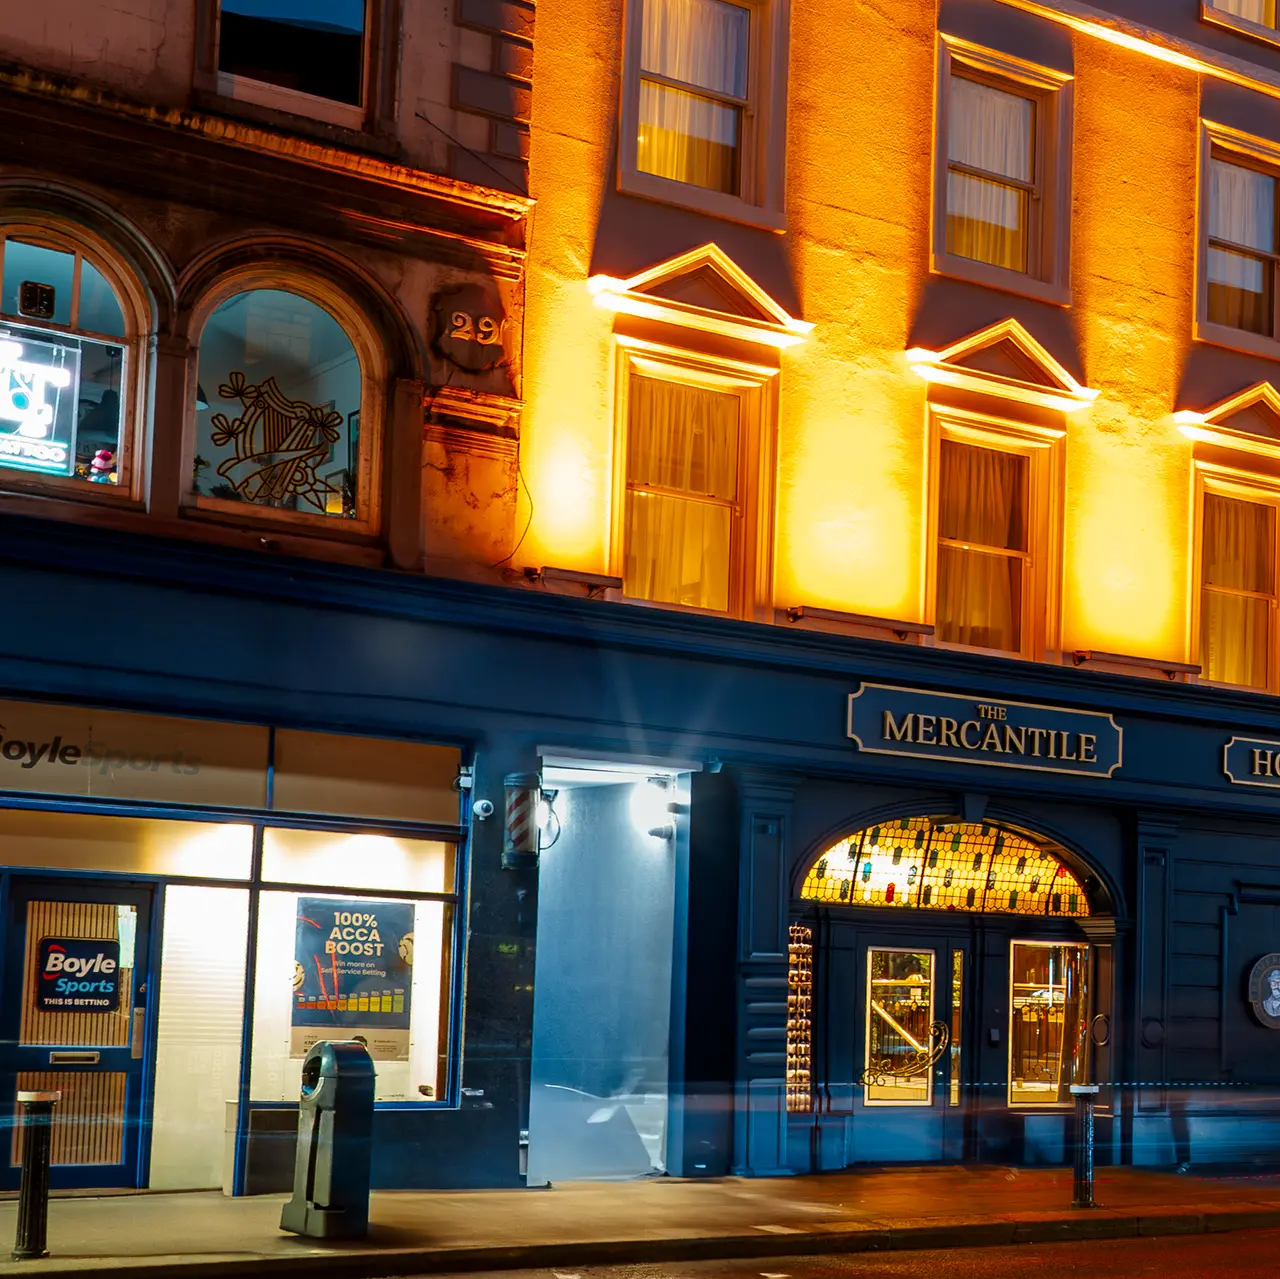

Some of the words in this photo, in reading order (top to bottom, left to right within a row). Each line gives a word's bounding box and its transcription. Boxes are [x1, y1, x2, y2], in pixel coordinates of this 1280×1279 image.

[451, 311, 499, 345] 29
[977, 704, 1007, 720] THE
[883, 710, 1097, 762] MERCANTILE
[334, 911, 378, 928] 100%
[329, 927, 381, 942] ACCA
[325, 941, 384, 957] BOOST
[45, 952, 117, 978] Boyle
[361, 968, 386, 978] Betting
[55, 978, 115, 995] Sports
[43, 997, 63, 1006] THIS
[64, 998, 73, 1006] IS
[74, 998, 110, 1007] BETTING
